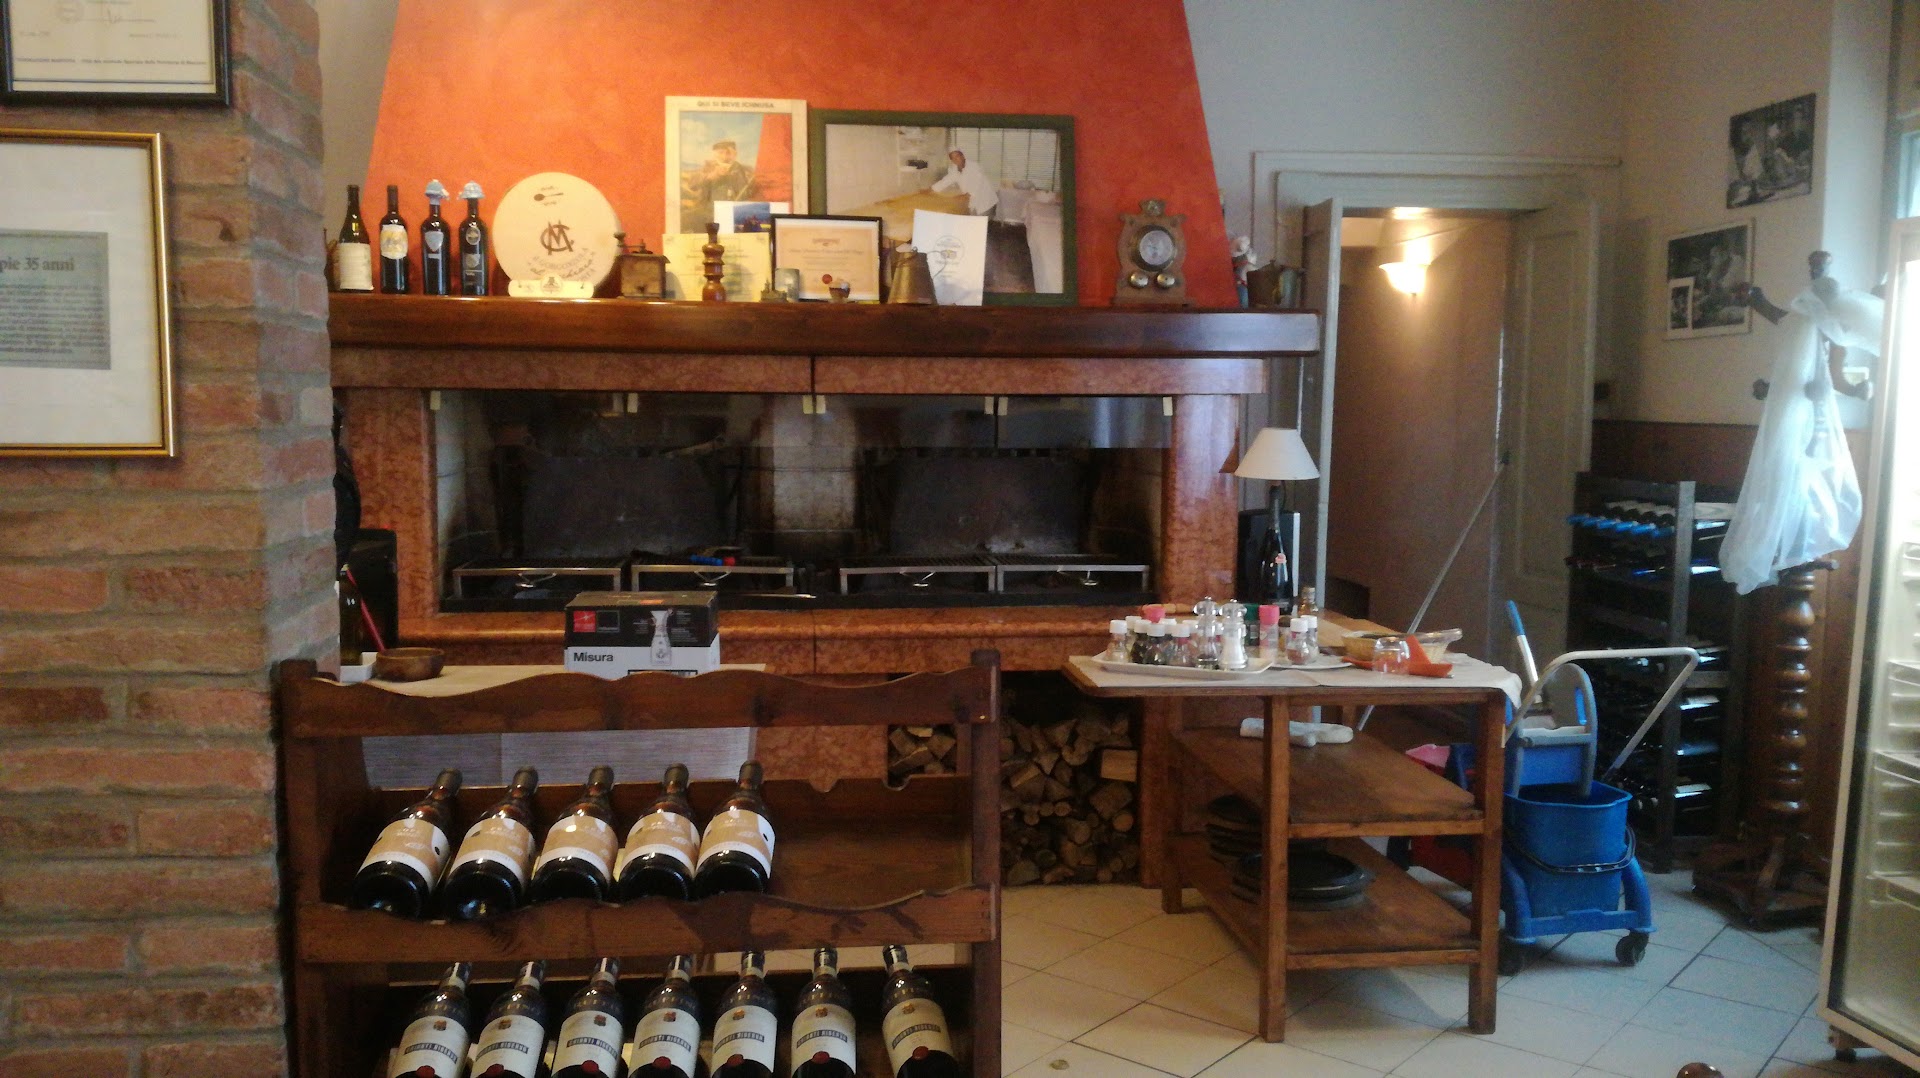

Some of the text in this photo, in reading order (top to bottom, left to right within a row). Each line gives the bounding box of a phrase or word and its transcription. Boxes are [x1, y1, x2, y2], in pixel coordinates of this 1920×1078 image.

[741, 101, 775, 109] ICHNUSA
[24, 257, 40, 271] 35
[42, 257, 75, 271] anni
[573, 651, 614, 663] Misura
